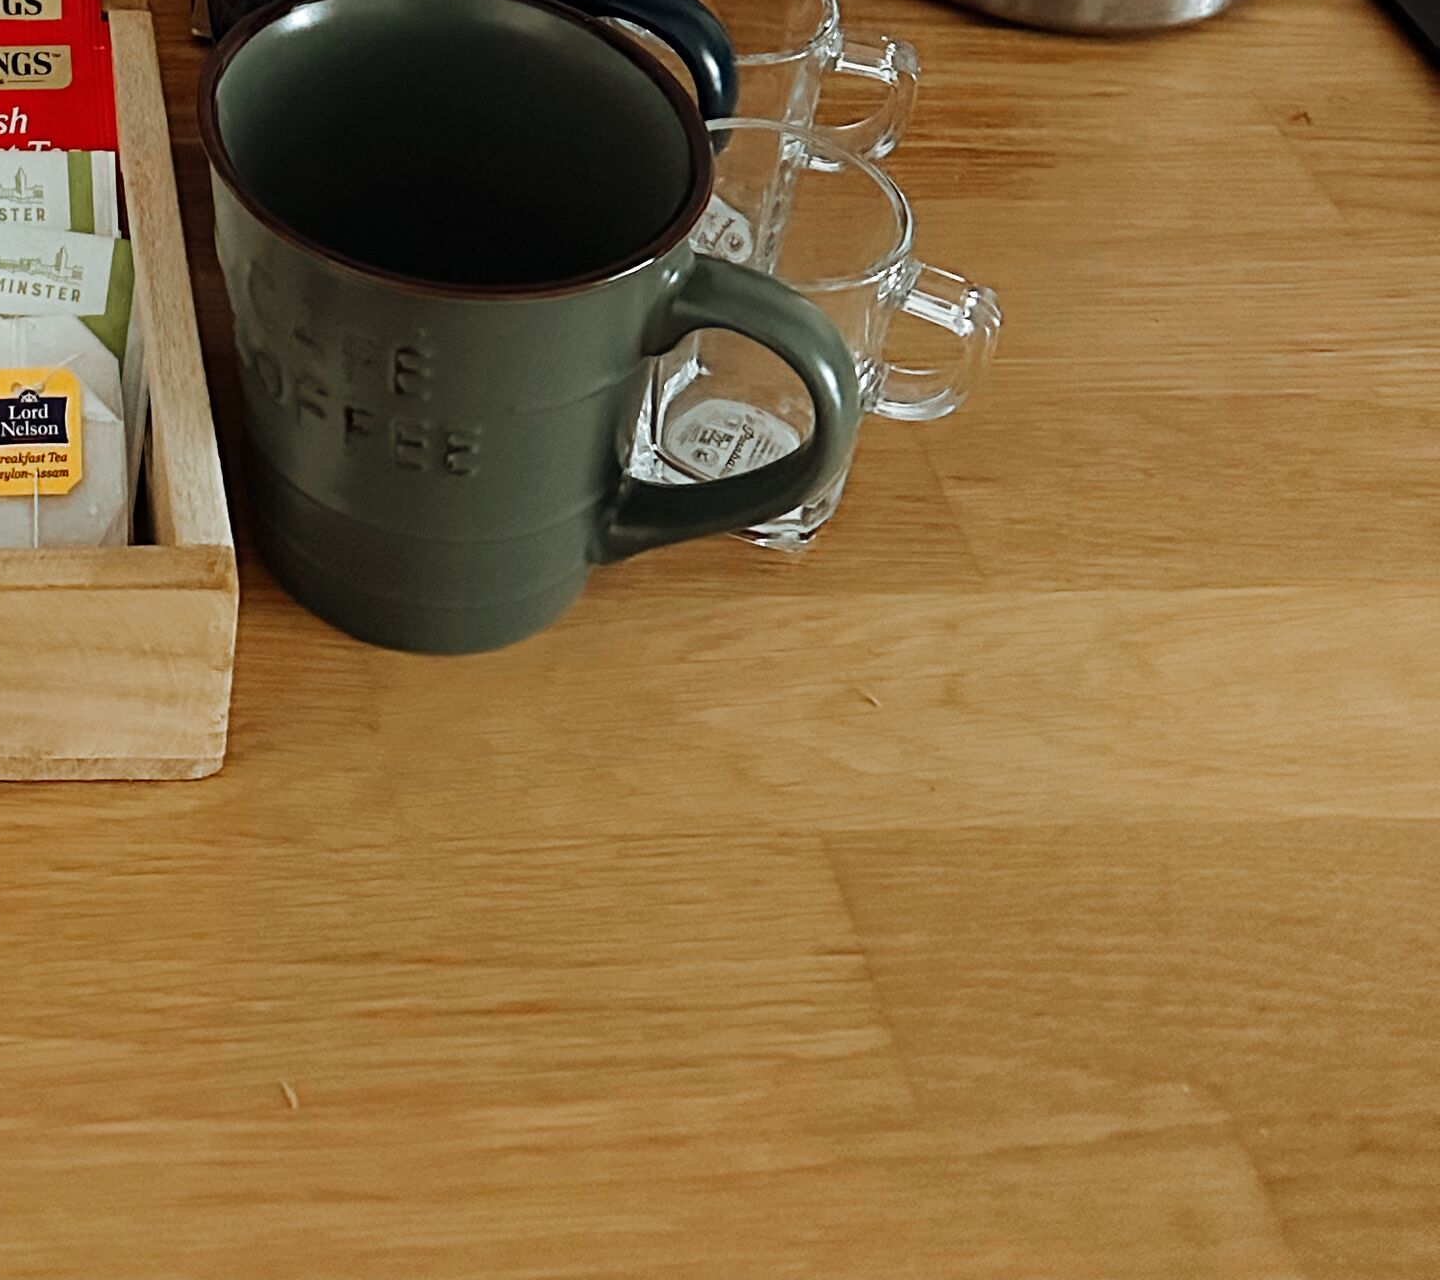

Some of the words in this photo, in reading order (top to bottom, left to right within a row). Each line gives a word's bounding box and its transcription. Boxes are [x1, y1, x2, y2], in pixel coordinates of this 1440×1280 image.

[8, 403, 49, 420] Lord
[0, 420, 59, 437] Nelson
[47, 451, 68, 463] Tea
